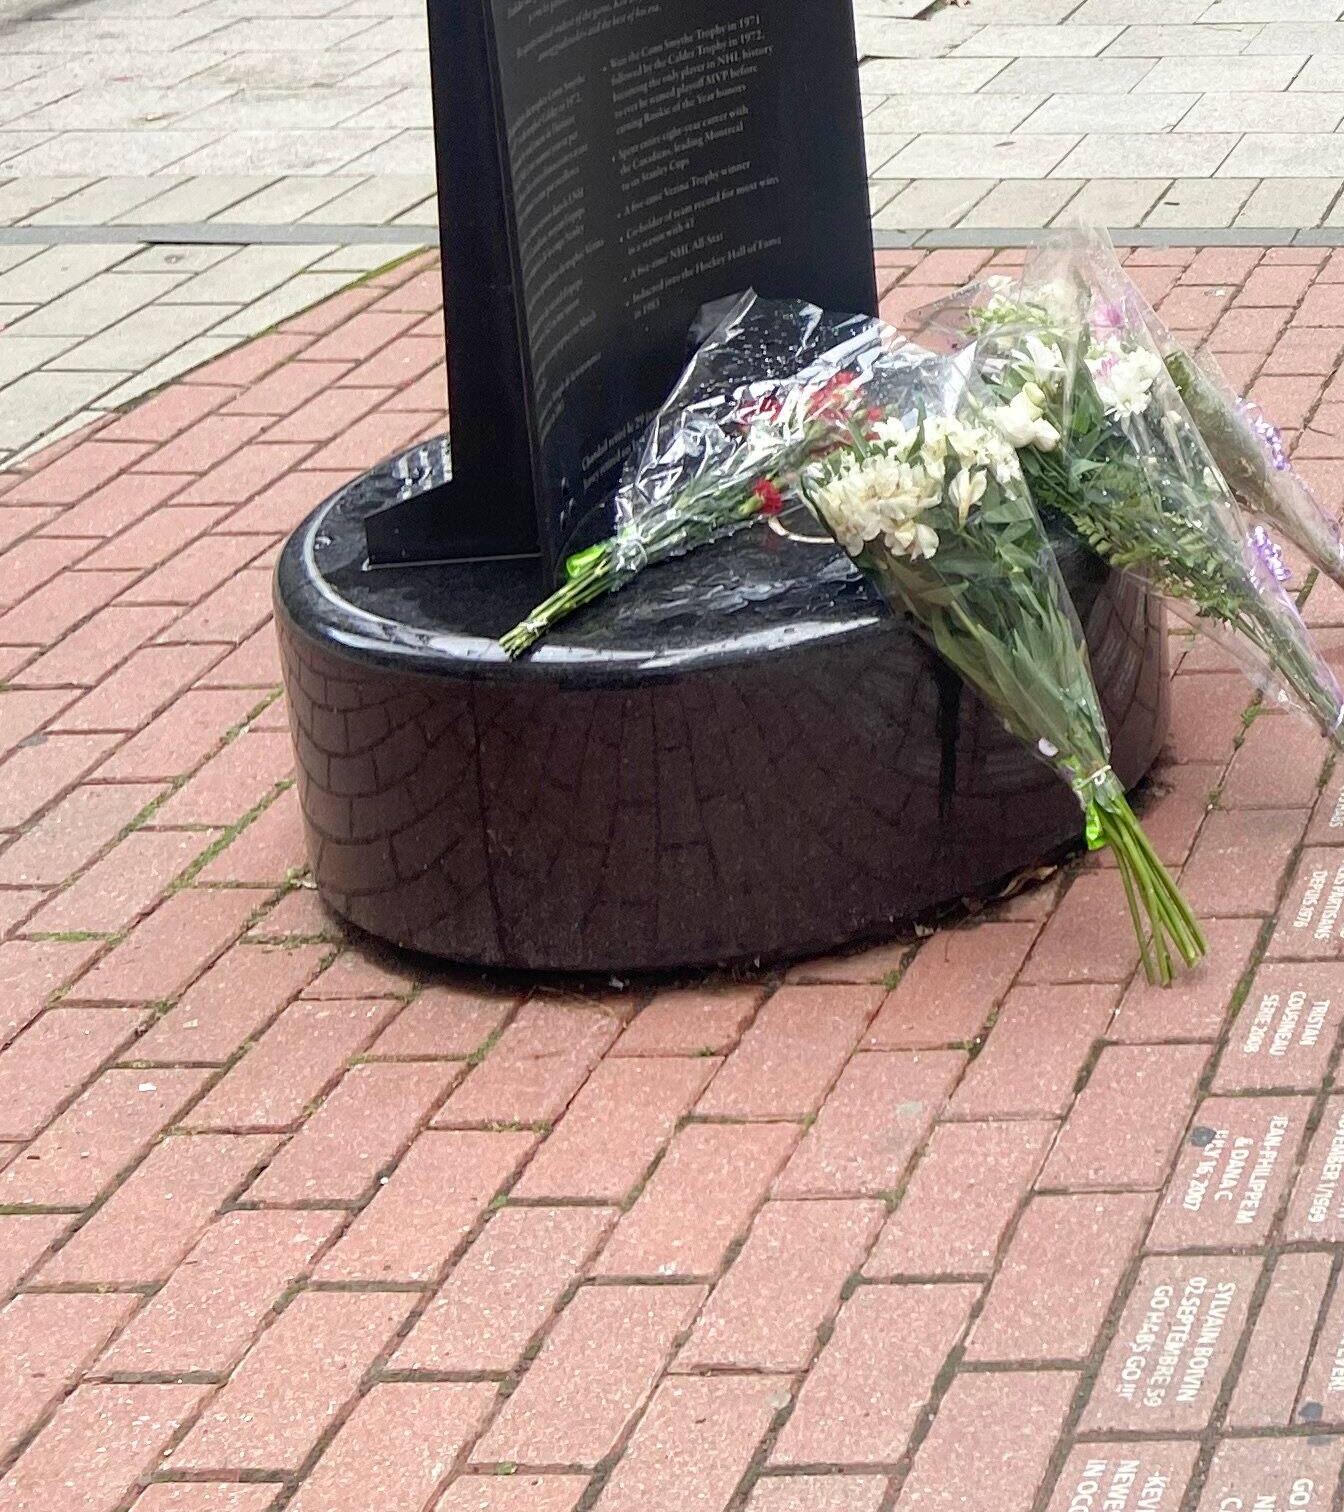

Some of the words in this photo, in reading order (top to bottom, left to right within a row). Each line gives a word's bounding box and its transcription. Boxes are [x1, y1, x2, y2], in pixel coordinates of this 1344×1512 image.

[1147, 1285, 1173, 1309] GO
[1183, 1277, 1207, 1294] 02
[1131, 1311, 1164, 1351] HABS
[1196, 1282, 1235, 1343] SYLVAIN
[1150, 1297, 1200, 1384] SEPTEMBRE
[1121, 1356, 1148, 1380] GO
[1177, 1347, 1214, 1400] BOIVIN
